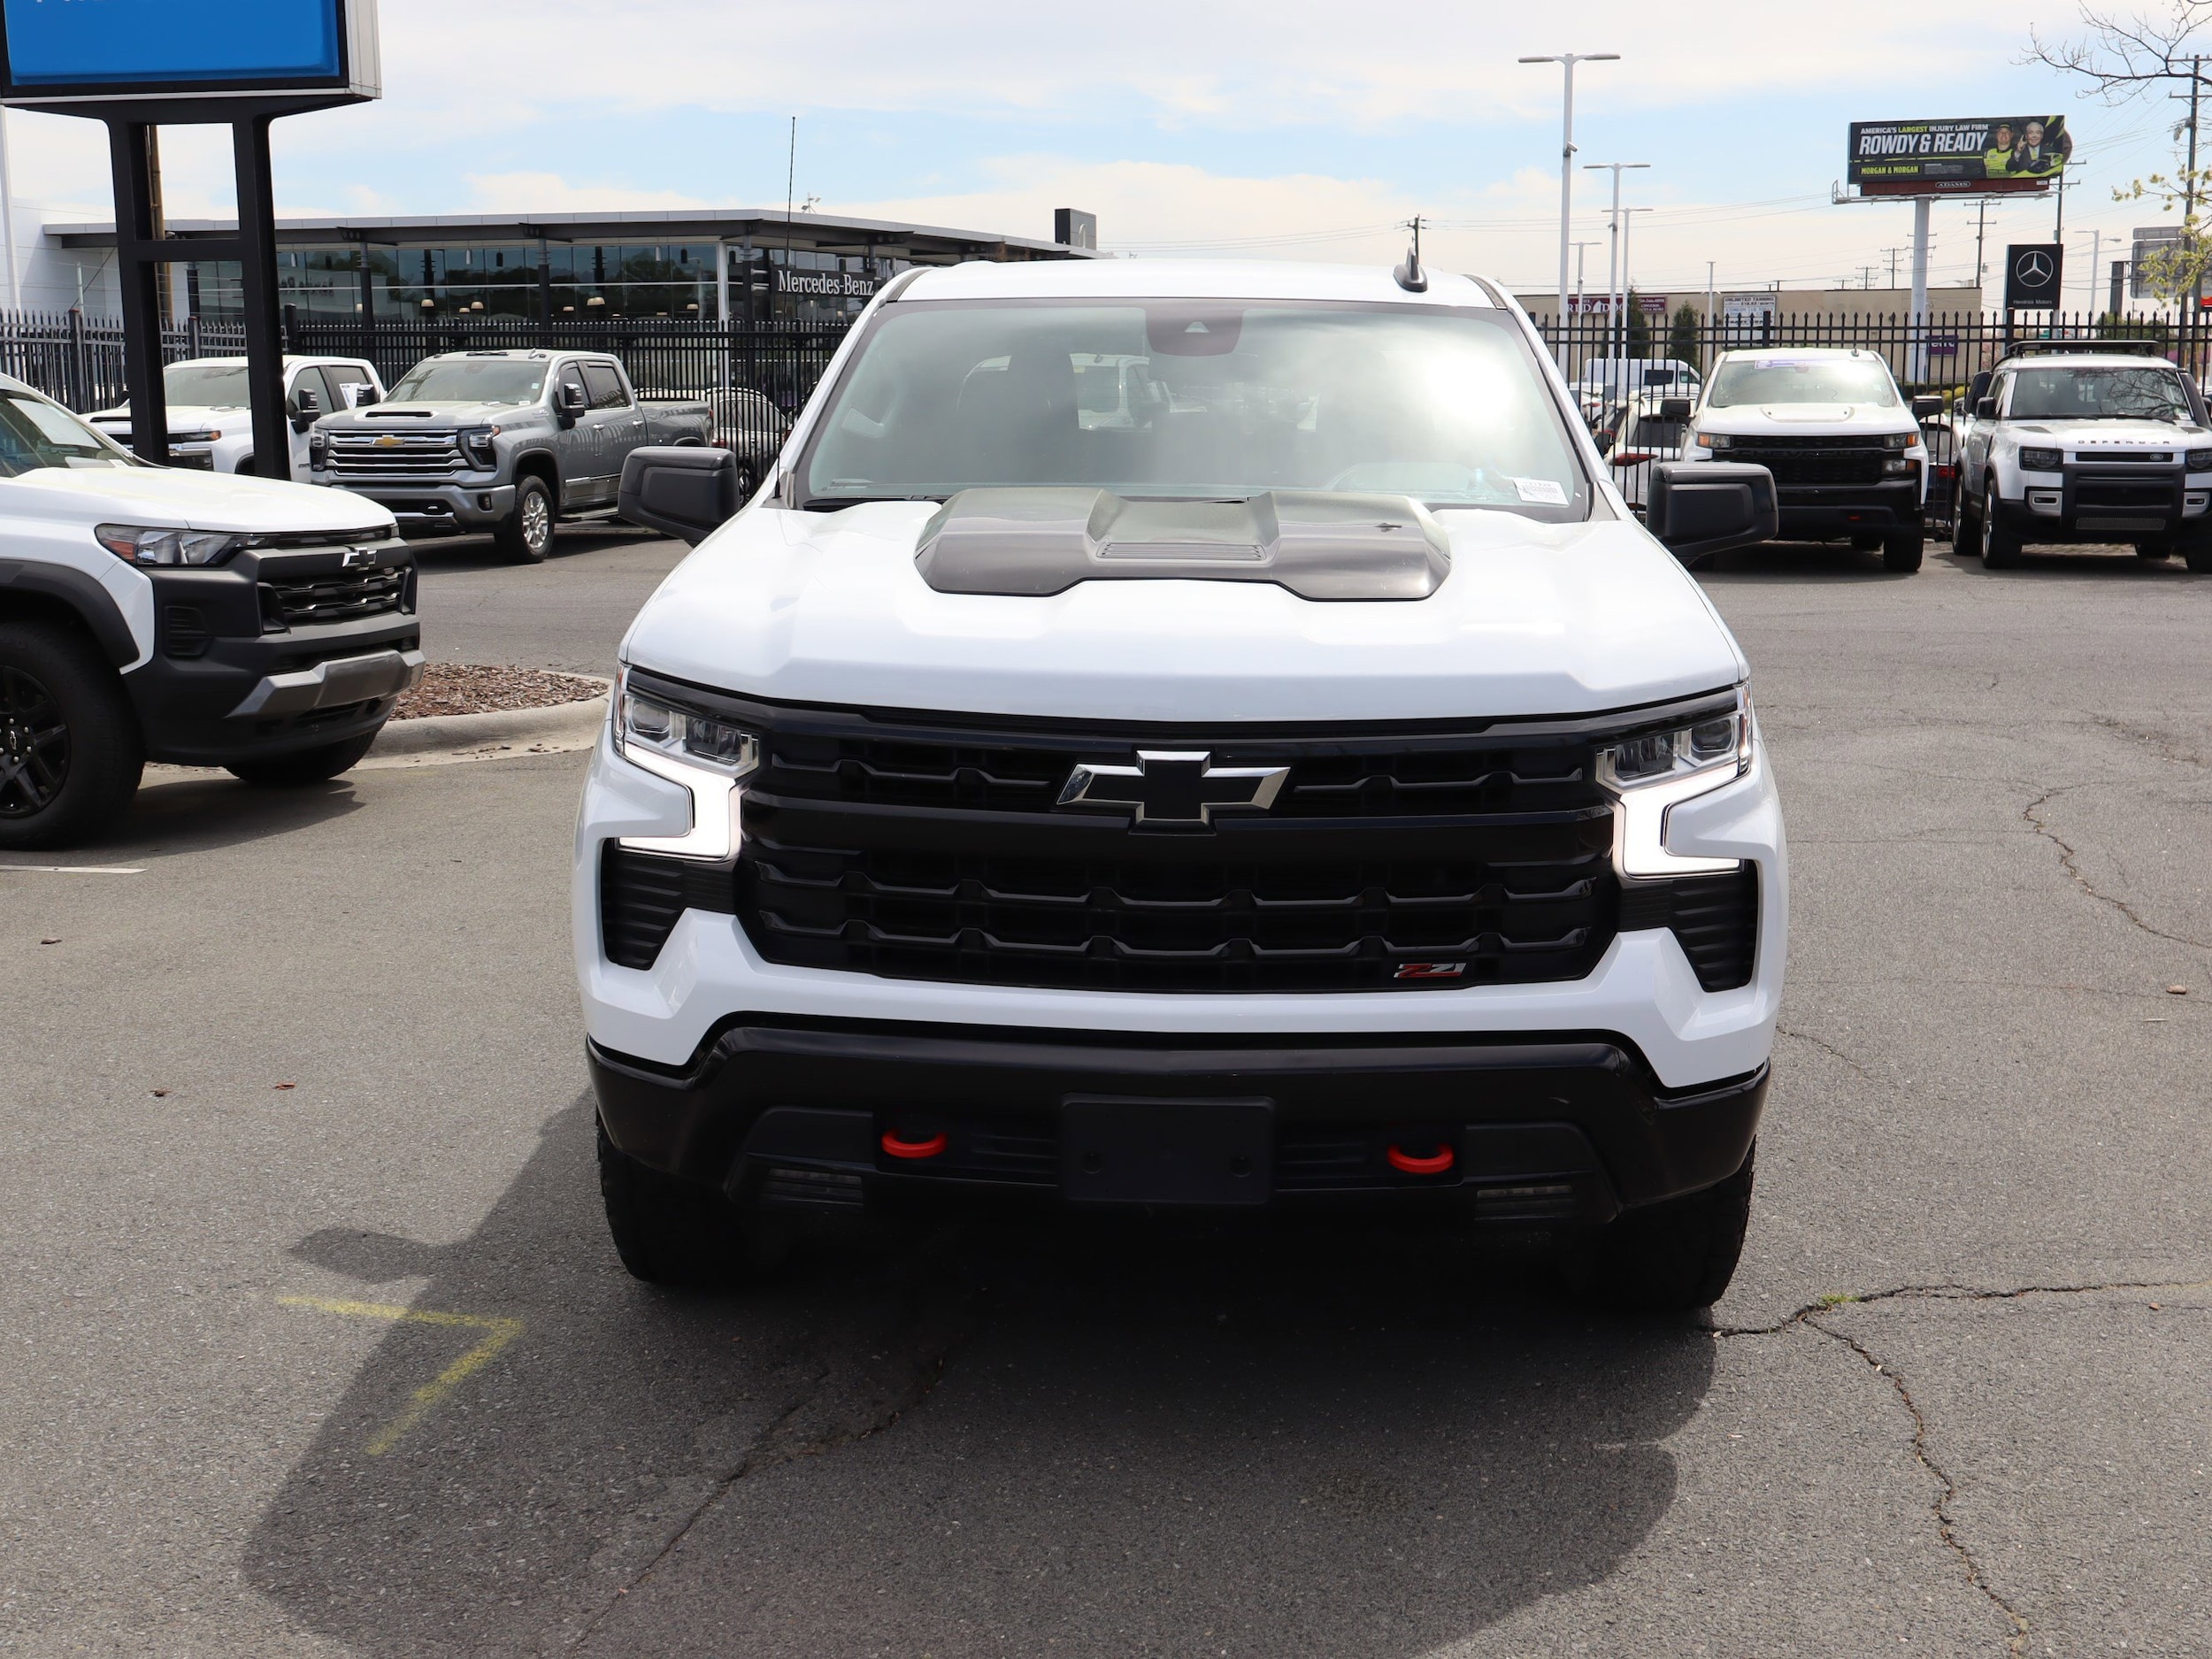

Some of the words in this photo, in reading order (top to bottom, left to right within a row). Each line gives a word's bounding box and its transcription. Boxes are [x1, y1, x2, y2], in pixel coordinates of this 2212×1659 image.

[1859, 134, 1920, 156] ROWDY
[1918, 134, 1931, 153] &
[1932, 132, 1988, 153] READY
[1861, 166, 1887, 175] MORGAN
[1893, 165, 1919, 174] MORGAN
[779, 270, 874, 296] Mercedes-Benz
[1394, 963, 1467, 979] Z71
